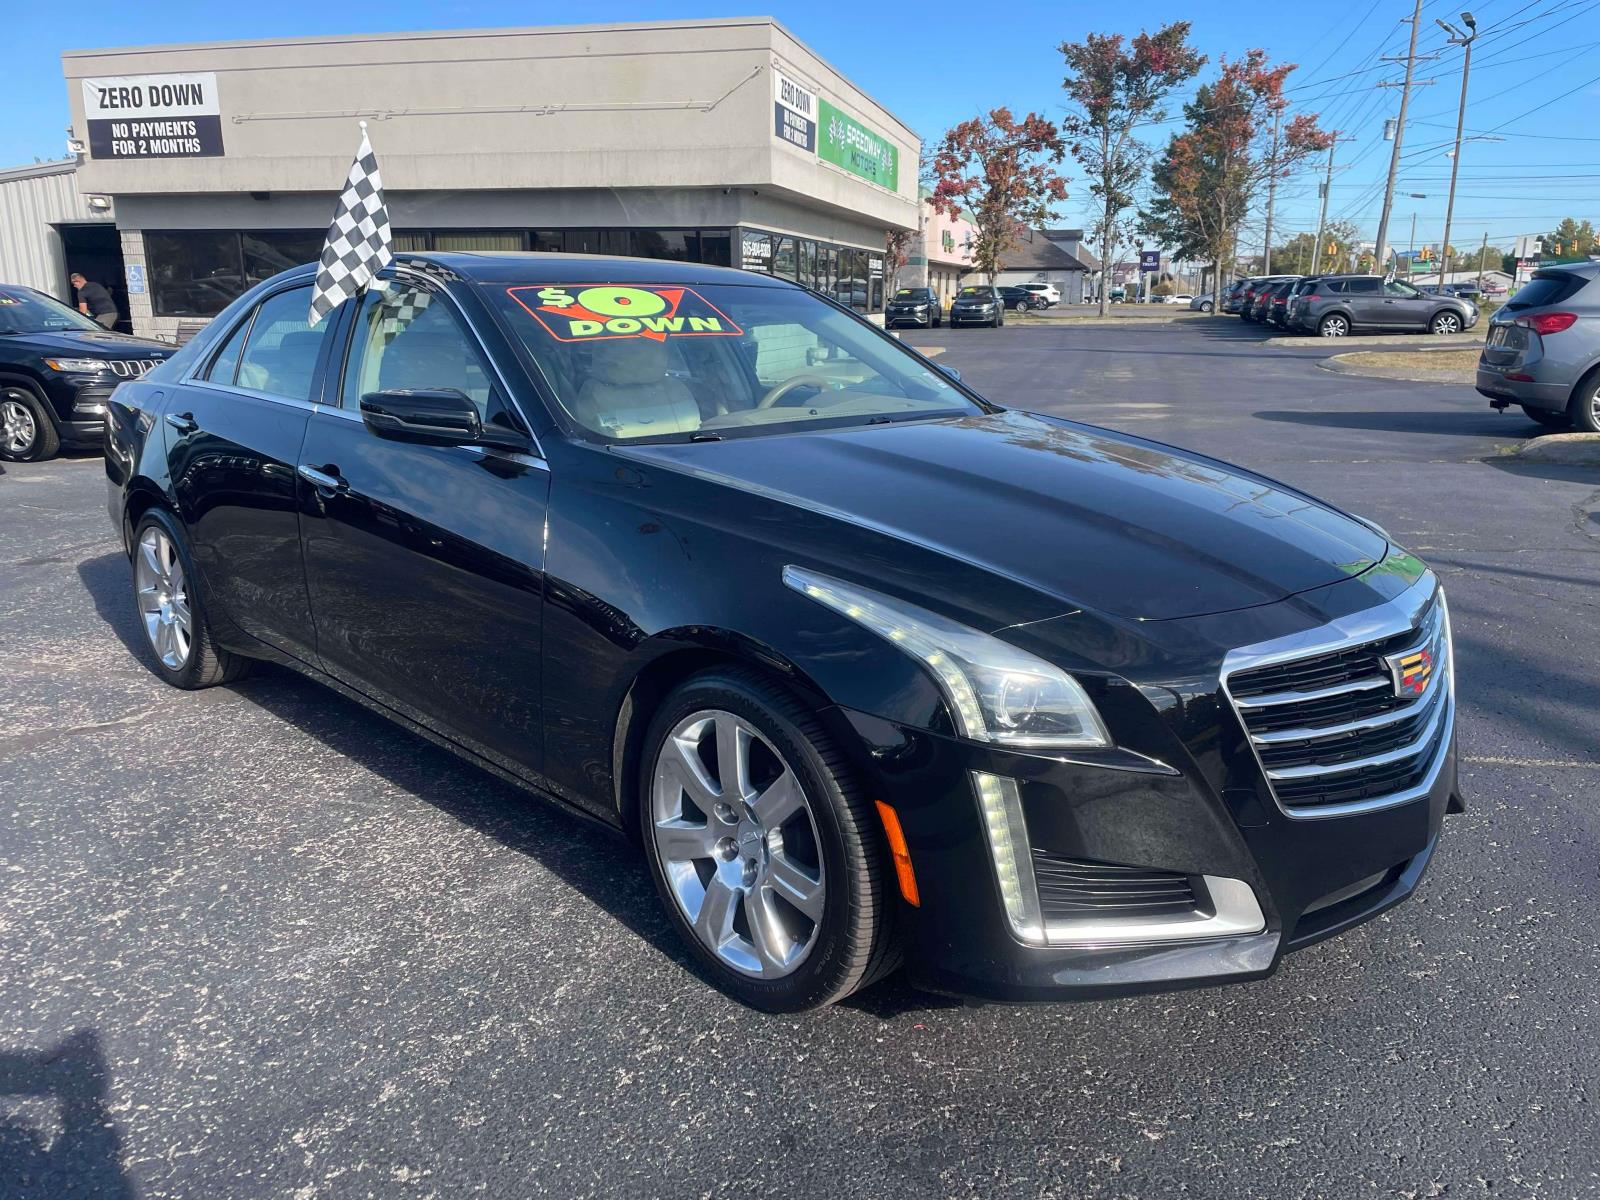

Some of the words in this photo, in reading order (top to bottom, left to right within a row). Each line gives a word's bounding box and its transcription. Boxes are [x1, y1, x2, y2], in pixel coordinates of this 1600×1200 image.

[98, 86, 143, 109] ZERO
[148, 83, 204, 107] DOWN
[781, 78, 795, 106] ZERO
[796, 87, 811, 115] DOWN
[111, 122, 128, 138] NO
[132, 120, 197, 138] PAYMENTS
[112, 140, 137, 155] FOR
[138, 139, 148, 154] 2
[150, 138, 201, 154] MONTHS
[846, 124, 882, 160] SPEEDWAY
[850, 151, 877, 176] MOTORS
[569, 317, 724, 336] DOWN
